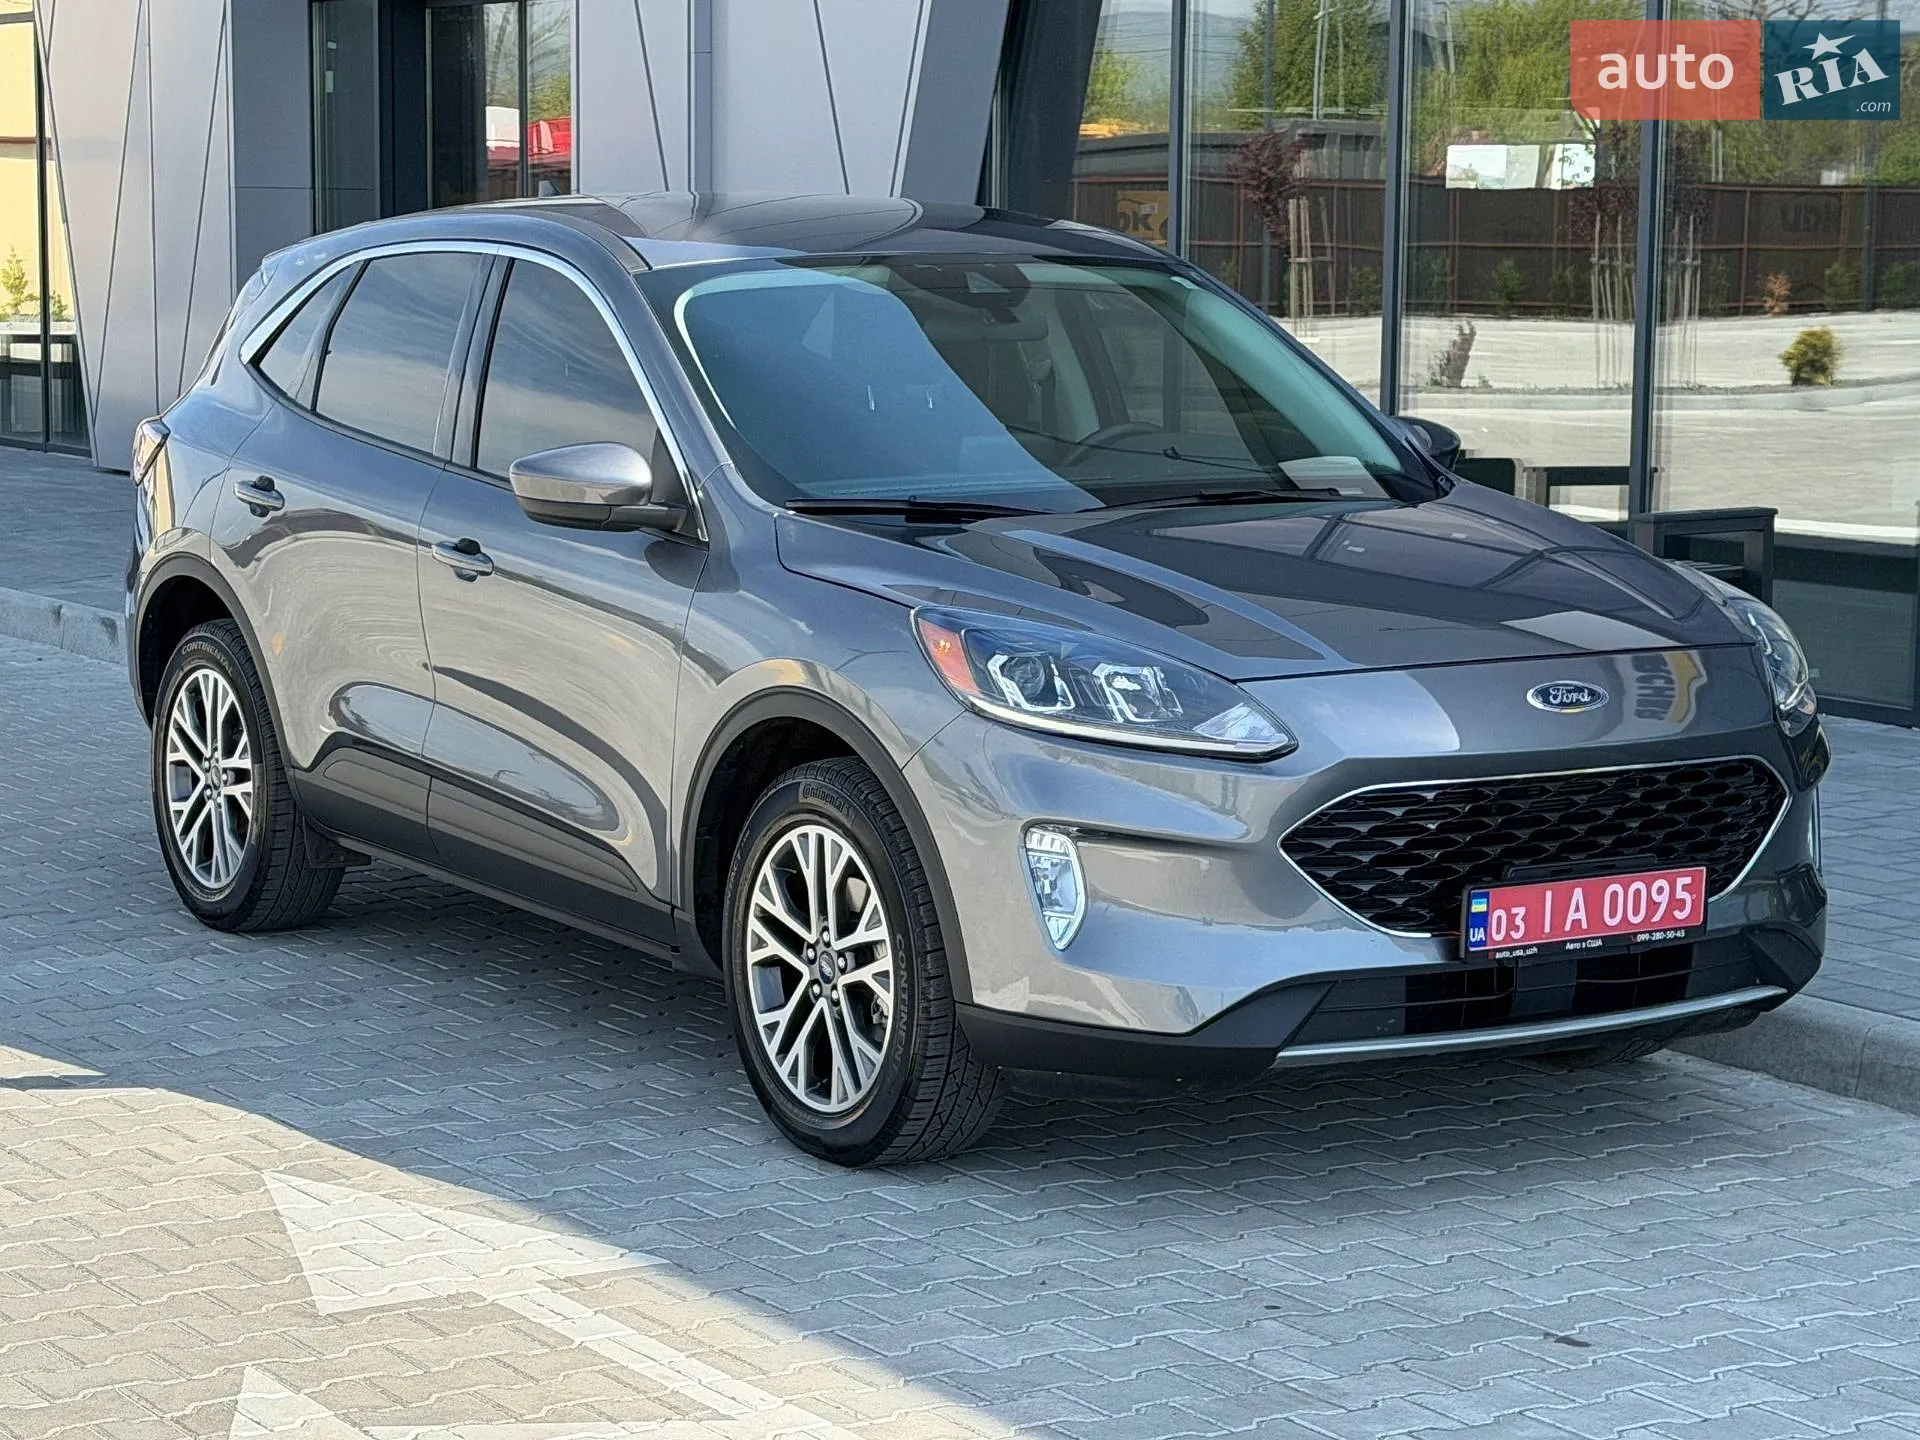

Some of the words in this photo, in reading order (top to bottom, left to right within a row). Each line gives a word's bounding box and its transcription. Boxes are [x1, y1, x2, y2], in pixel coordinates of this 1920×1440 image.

[1549, 686, 1591, 704] Ford
[1491, 907, 1526, 942] 03
[1602, 876, 1693, 927] 0095
[1469, 927, 1486, 943] UA
